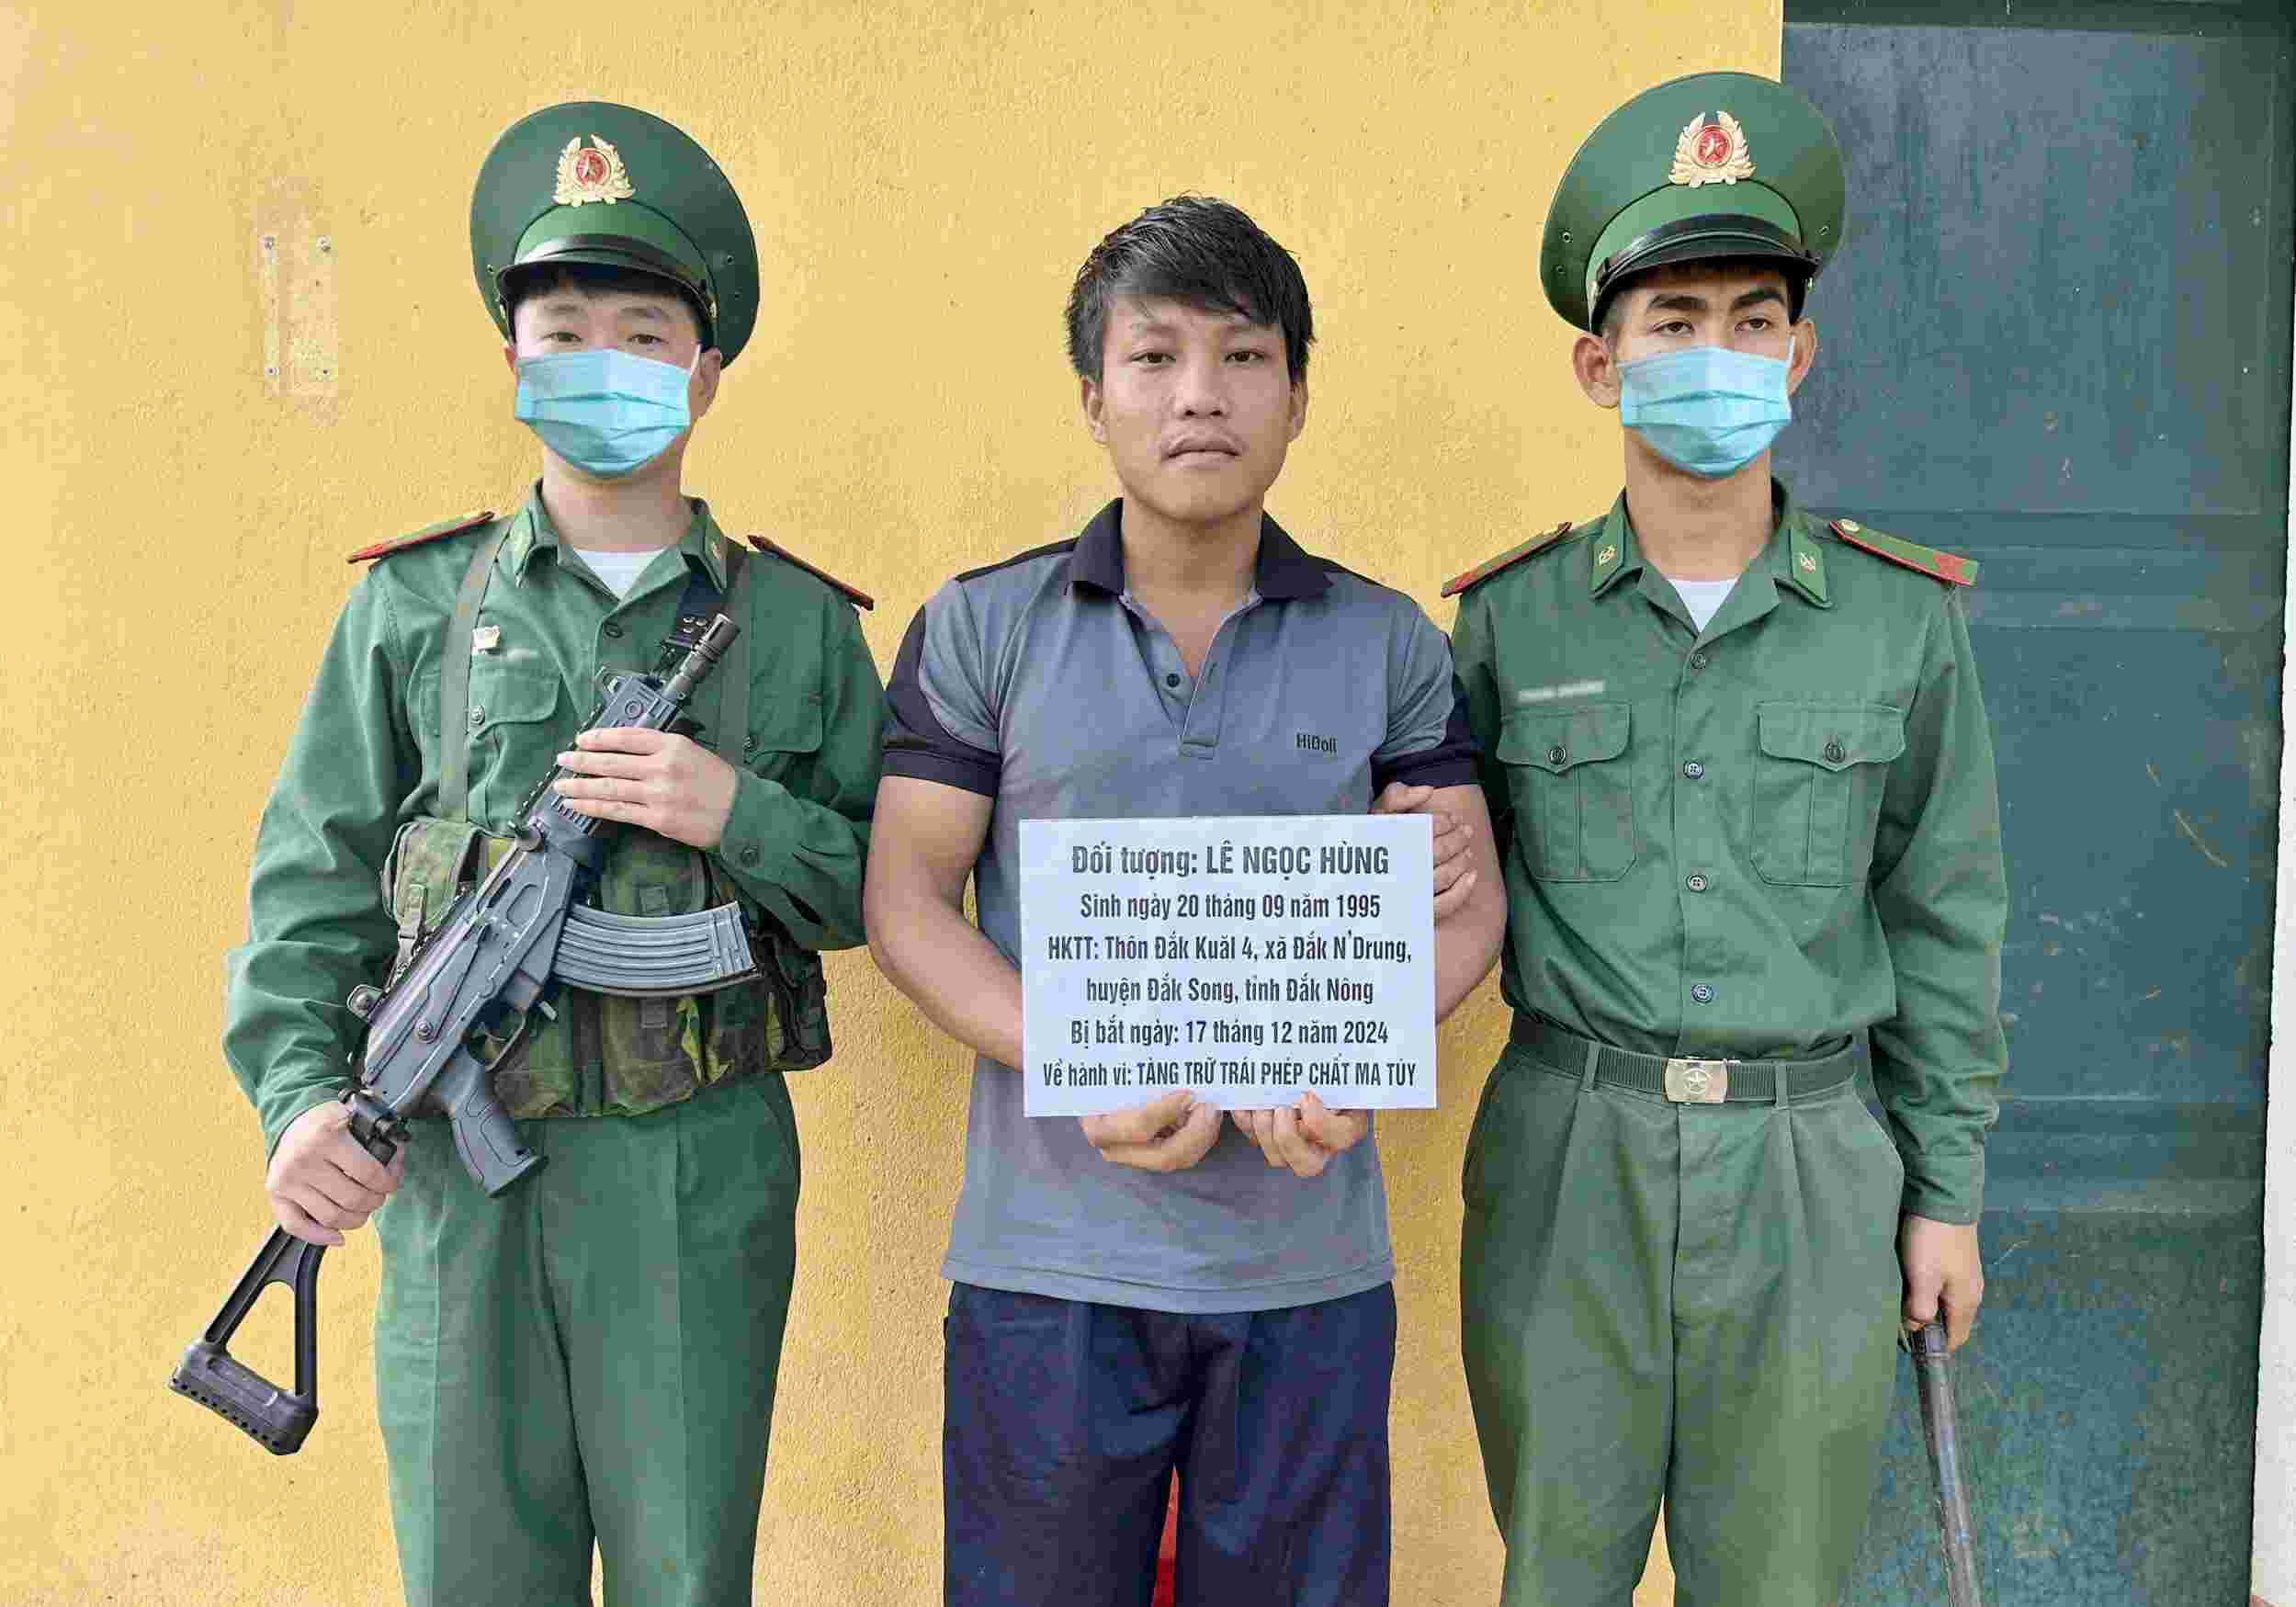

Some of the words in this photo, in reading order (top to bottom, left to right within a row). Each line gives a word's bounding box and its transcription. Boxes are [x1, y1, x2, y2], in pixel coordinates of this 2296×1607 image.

[1071, 841, 1113, 874] Đối
[1120, 847, 1198, 879] tượng:
[1205, 840, 1234, 874] LÊ
[1242, 846, 1311, 880] NGỌC
[1319, 841, 1389, 875] HÙNG
[1080, 894, 1122, 918] Sinh
[1127, 893, 1171, 921] ngày
[1176, 894, 1199, 917] 20
[1205, 893, 1256, 921] tháng
[1261, 895, 1284, 918] 09
[1290, 893, 1329, 918] năm
[1336, 895, 1381, 918] 1995
[1048, 936, 1099, 960] HKTT:
[1103, 935, 1148, 959] Thôn
[1241, 936, 1259, 961] 4,
[1263, 936, 1287, 959] xã
[1086, 978, 1141, 1006] huyện
[1187, 978, 1239, 1003] Song,
[1244, 976, 1280, 1002] tỉnh
[1326, 978, 1374, 1004] Nông
[1070, 1020, 1089, 1049] Bị
[1095, 1014, 1125, 1044] bắt
[1130, 1019, 1180, 1047] ngày:
[1185, 1021, 1207, 1043] 17
[1212, 1014, 1264, 1046] tháng
[1271, 1022, 1293, 1043] 12
[1298, 1020, 1338, 1044] năm
[1343, 1021, 1389, 1044] 2024
[1043, 1058, 1063, 1086] Về
[1068, 1060, 1108, 1086] hành
[1113, 1061, 1132, 1086] vi:
[1136, 1058, 1180, 1085] TÀNG
[1183, 1057, 1217, 1084] TRỮ
[1219, 1057, 1256, 1084] TRÁI
[1261, 1058, 1304, 1085] PHÉP
[1308, 1053, 1351, 1085] CHẤT
[1354, 1063, 1382, 1086] MA
